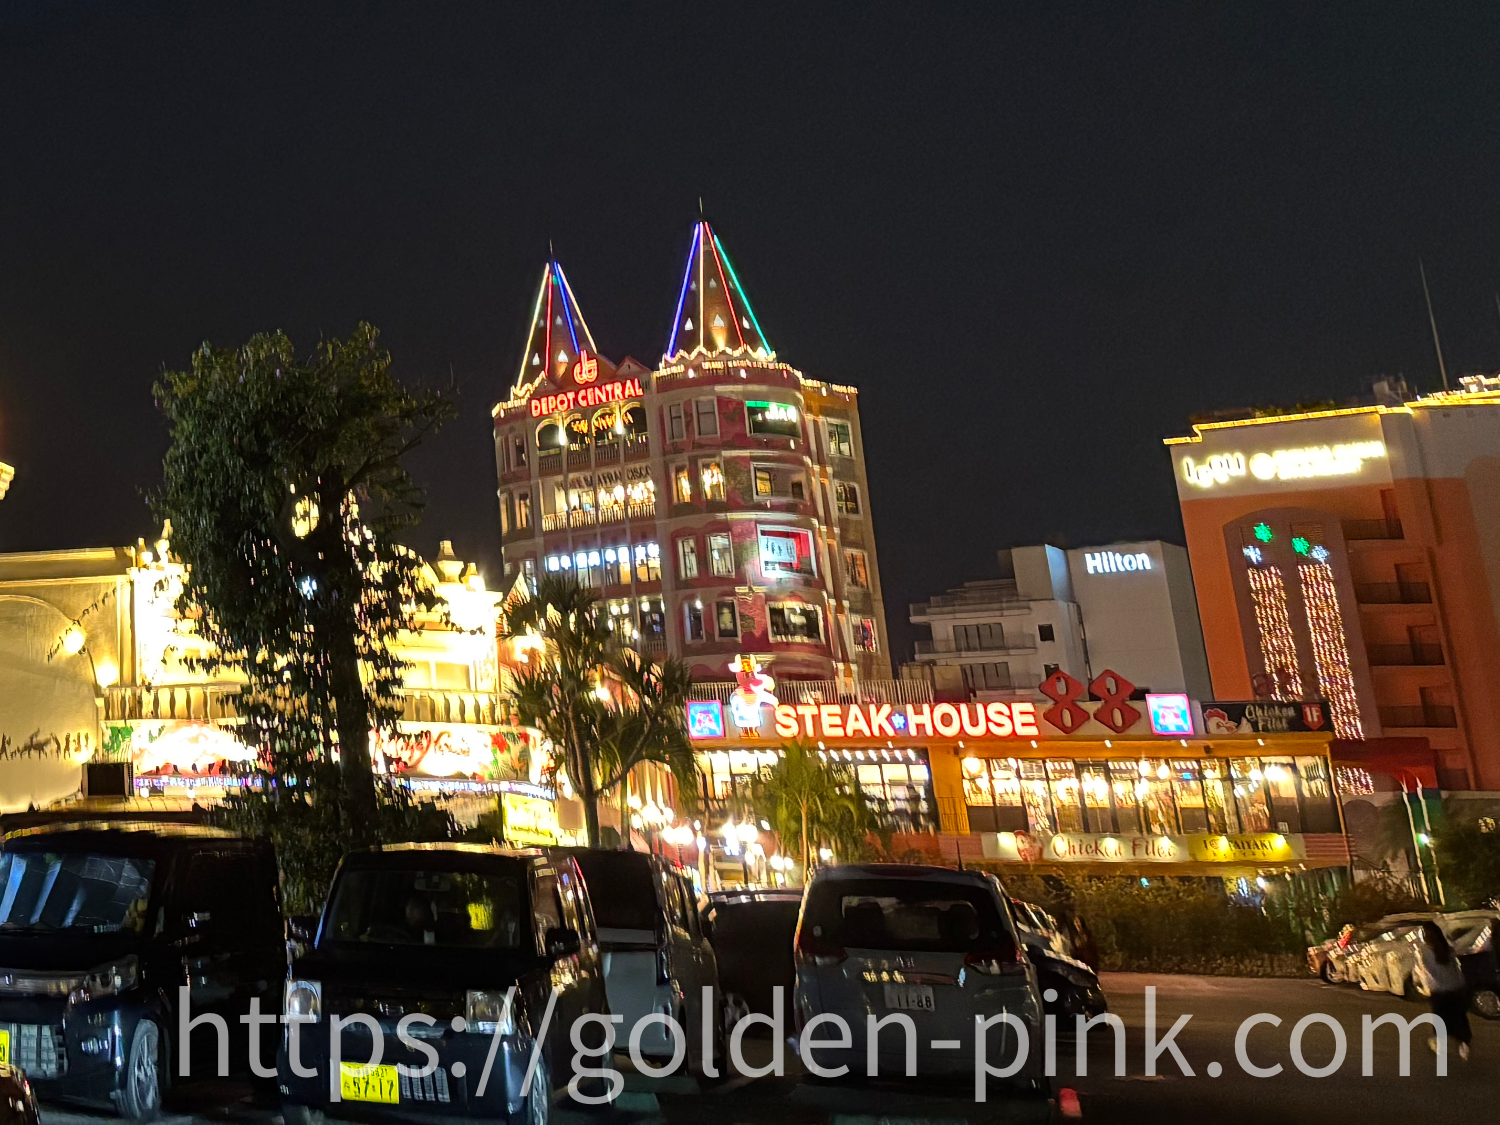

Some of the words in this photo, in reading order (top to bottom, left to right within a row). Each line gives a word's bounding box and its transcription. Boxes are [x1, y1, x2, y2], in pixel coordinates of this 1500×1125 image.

[530, 391, 576, 418] DEPOT
[577, 377, 644, 408] CENTRAL
[1084, 550, 1152, 575] Hilton
[774, 703, 895, 739] STEAK
[906, 701, 1040, 738] HOUSE
[1039, 669, 1142, 735] 88
